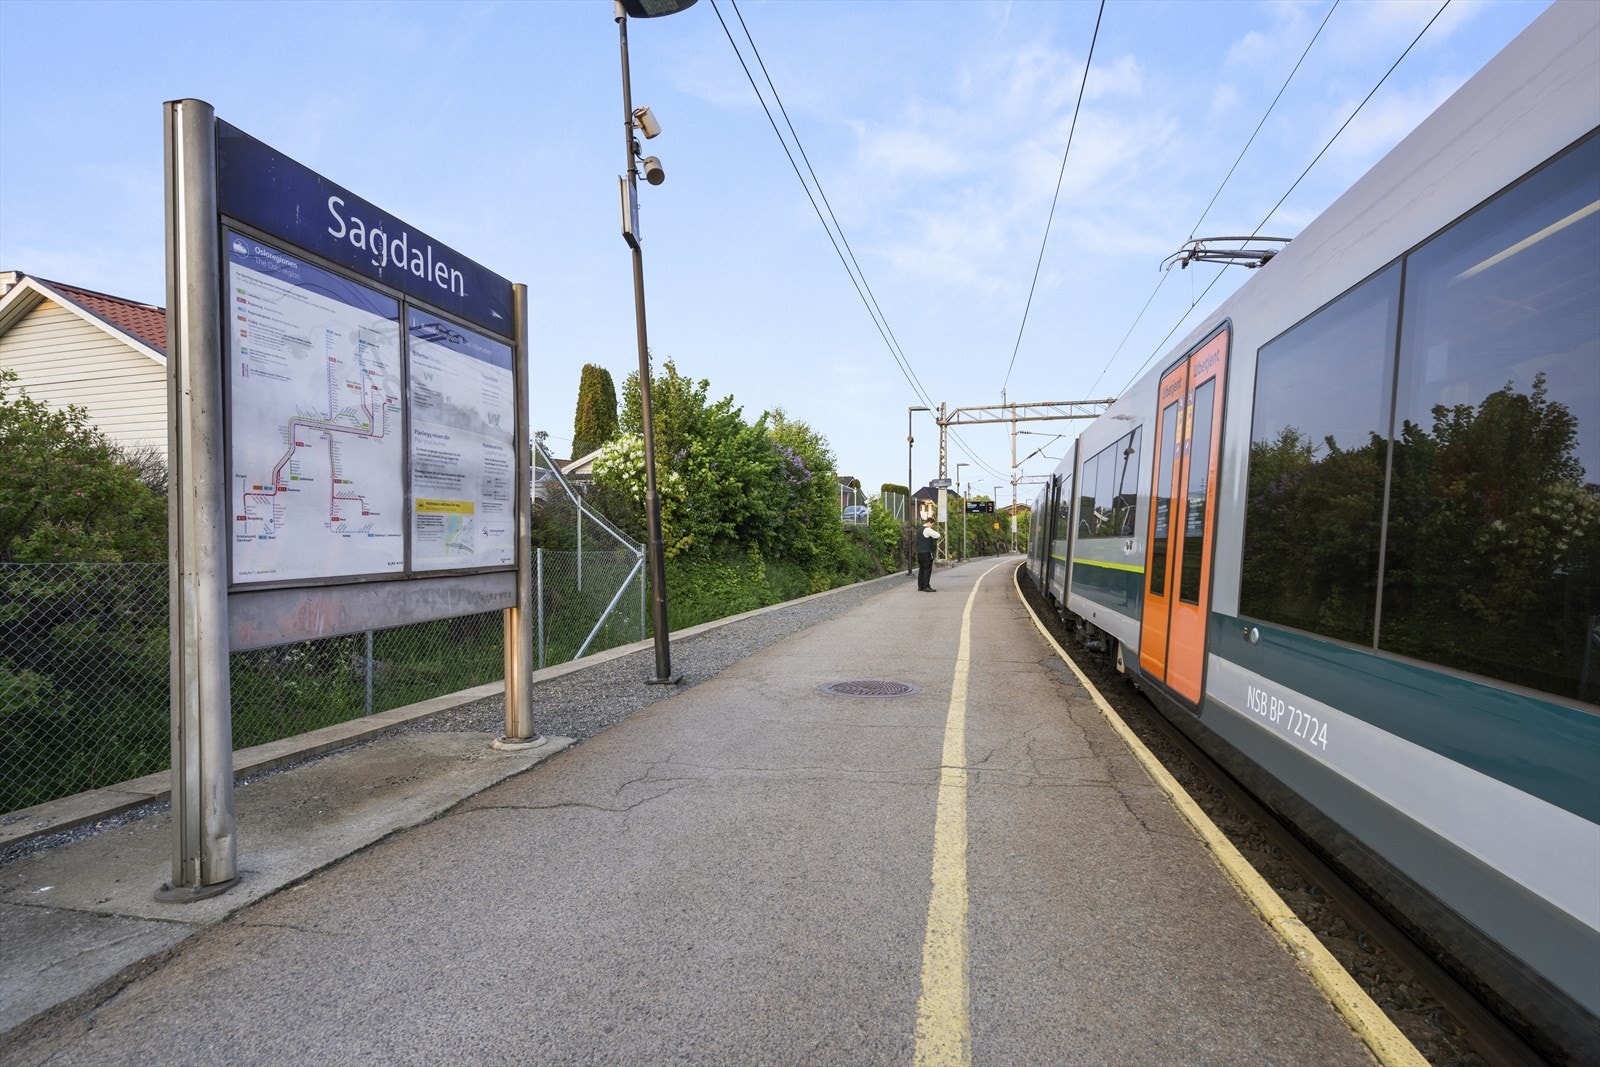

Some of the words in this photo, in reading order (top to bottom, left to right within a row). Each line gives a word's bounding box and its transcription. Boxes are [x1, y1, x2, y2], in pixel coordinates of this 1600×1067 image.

[254, 246, 298, 269] Osloregionen
[327, 196, 465, 297] Sagdalen
[255, 256, 267, 267] The
[268, 261, 281, 273] Oslo
[282, 267, 301, 281] region
[1194, 350, 1220, 377] Ubetjent
[1247, 685, 1268, 716] NSB
[1269, 696, 1285, 724] BP
[1287, 705, 1328, 751] 72724
